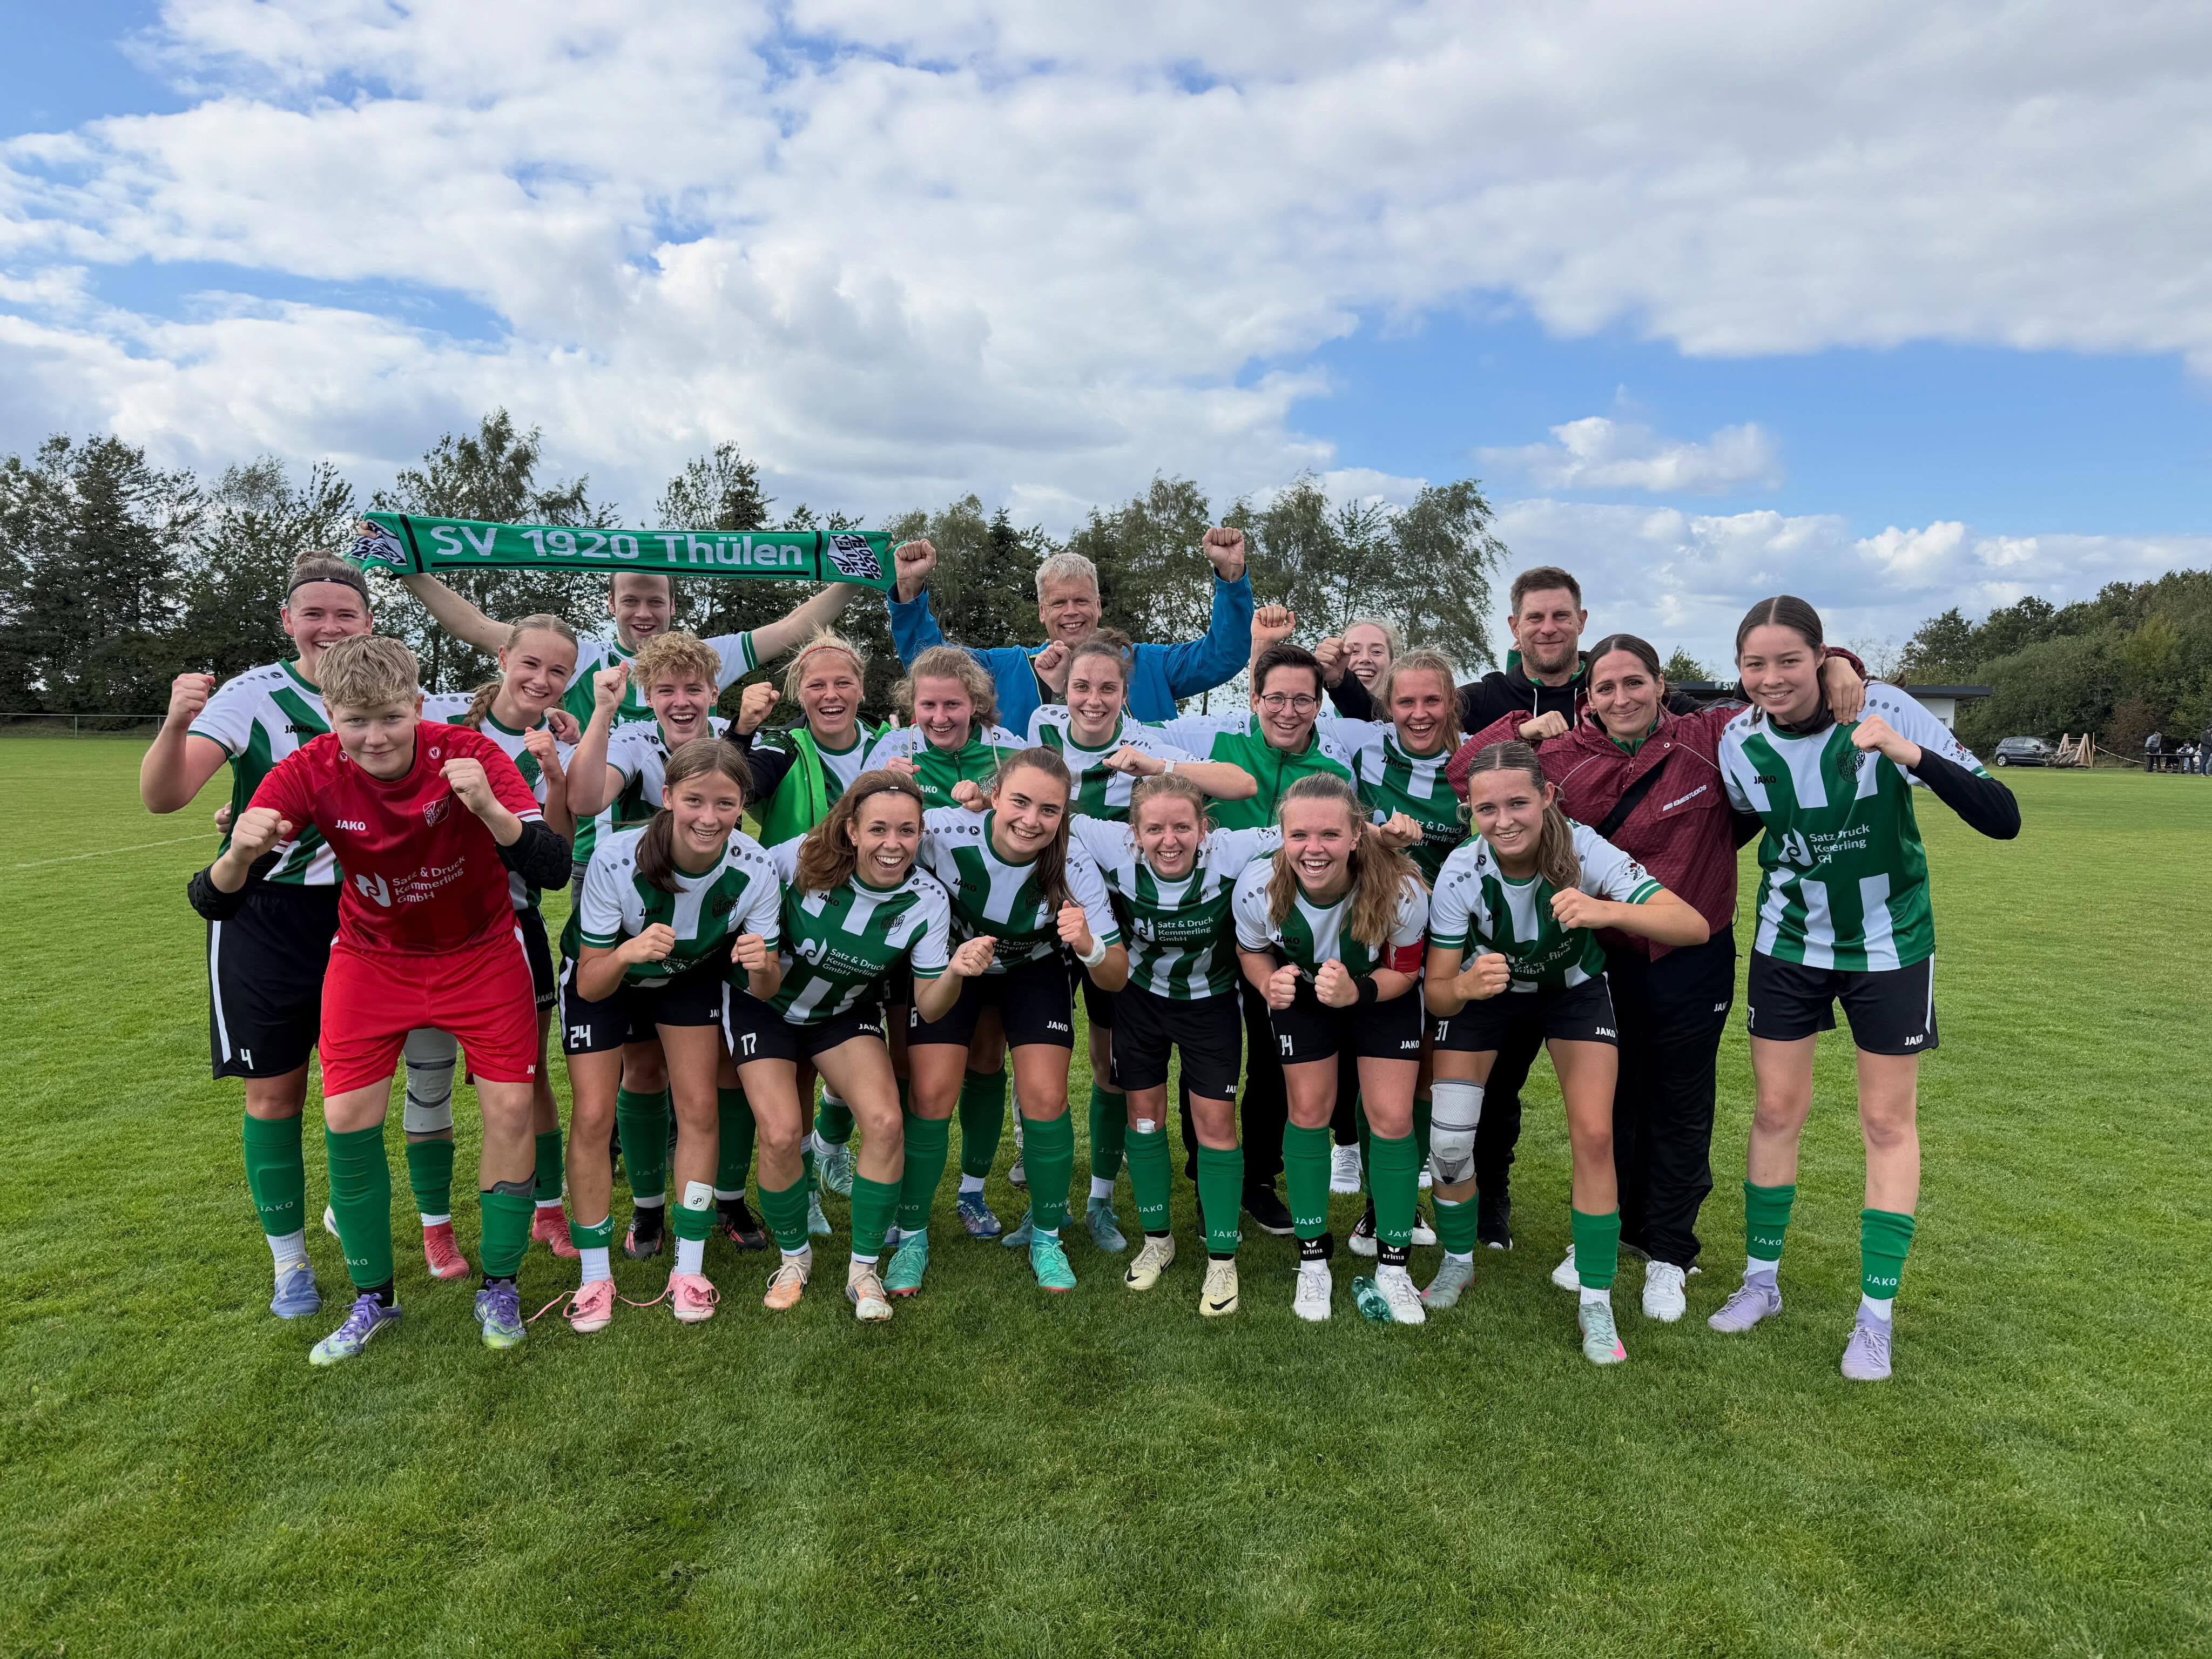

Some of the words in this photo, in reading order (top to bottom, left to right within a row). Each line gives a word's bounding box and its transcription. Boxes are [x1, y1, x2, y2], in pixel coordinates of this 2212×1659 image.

[430, 525, 498, 556] SV
[520, 529, 639, 559] 1920
[654, 534, 803, 565] Thülen
[1723, 682, 1736, 690] SV
[285, 725, 313, 734] JAKO
[1381, 756, 1404, 768] JAKO
[1754, 775, 1776, 784] JAKO
[919, 785, 938, 794] AKO
[335, 819, 366, 831] JAKO
[1426, 821, 1434, 830] &
[1422, 832, 1457, 844] merling
[1809, 833, 1836, 842] Satz
[392, 871, 417, 886] Satz
[420, 867, 429, 878] &
[431, 855, 466, 878] Druck
[395, 868, 464, 895] Kemmerling
[952, 878, 977, 892] JAKO
[397, 891, 435, 903] GmbH
[818, 892, 840, 907] JAKO
[639, 906, 663, 916] JAKO
[1188, 916, 1214, 927] Druck
[1158, 927, 1211, 936] Kemmerling
[1274, 935, 1300, 945] JAKO
[830, 948, 850, 961] Satz
[860, 959, 886, 971] Druck
[822, 963, 851, 976] GmbH
[826, 956, 878, 977] Kemmerling
[536, 992, 553, 1004] JAKO
[859, 1023, 880, 1033] JAKO
[1047, 1020, 1068, 1032] JAKO
[1435, 1021, 1449, 1041] 31
[570, 1024, 591, 1048] 24
[1595, 1027, 1616, 1038] JAKO
[741, 1032, 757, 1056] 17
[1279, 1035, 1293, 1056] 14
[1400, 1040, 1420, 1049] JAKO
[1905, 1034, 1923, 1046] JAKO
[240, 1048, 254, 1070] 4
[1225, 1084, 1237, 1094] JAK
[260, 1201, 293, 1212] JAKO
[1138, 1204, 1163, 1213] JAKO
[1295, 1216, 1322, 1225] JAKO
[772, 1228, 797, 1236] AKO
[1213, 1229, 1237, 1238] JAKO
[1388, 1229, 1413, 1238] JAKO
[1752, 1236, 1782, 1246] JAKO
[344, 1256, 368, 1266] AKO
[1866, 1274, 1897, 1286] JAKO
